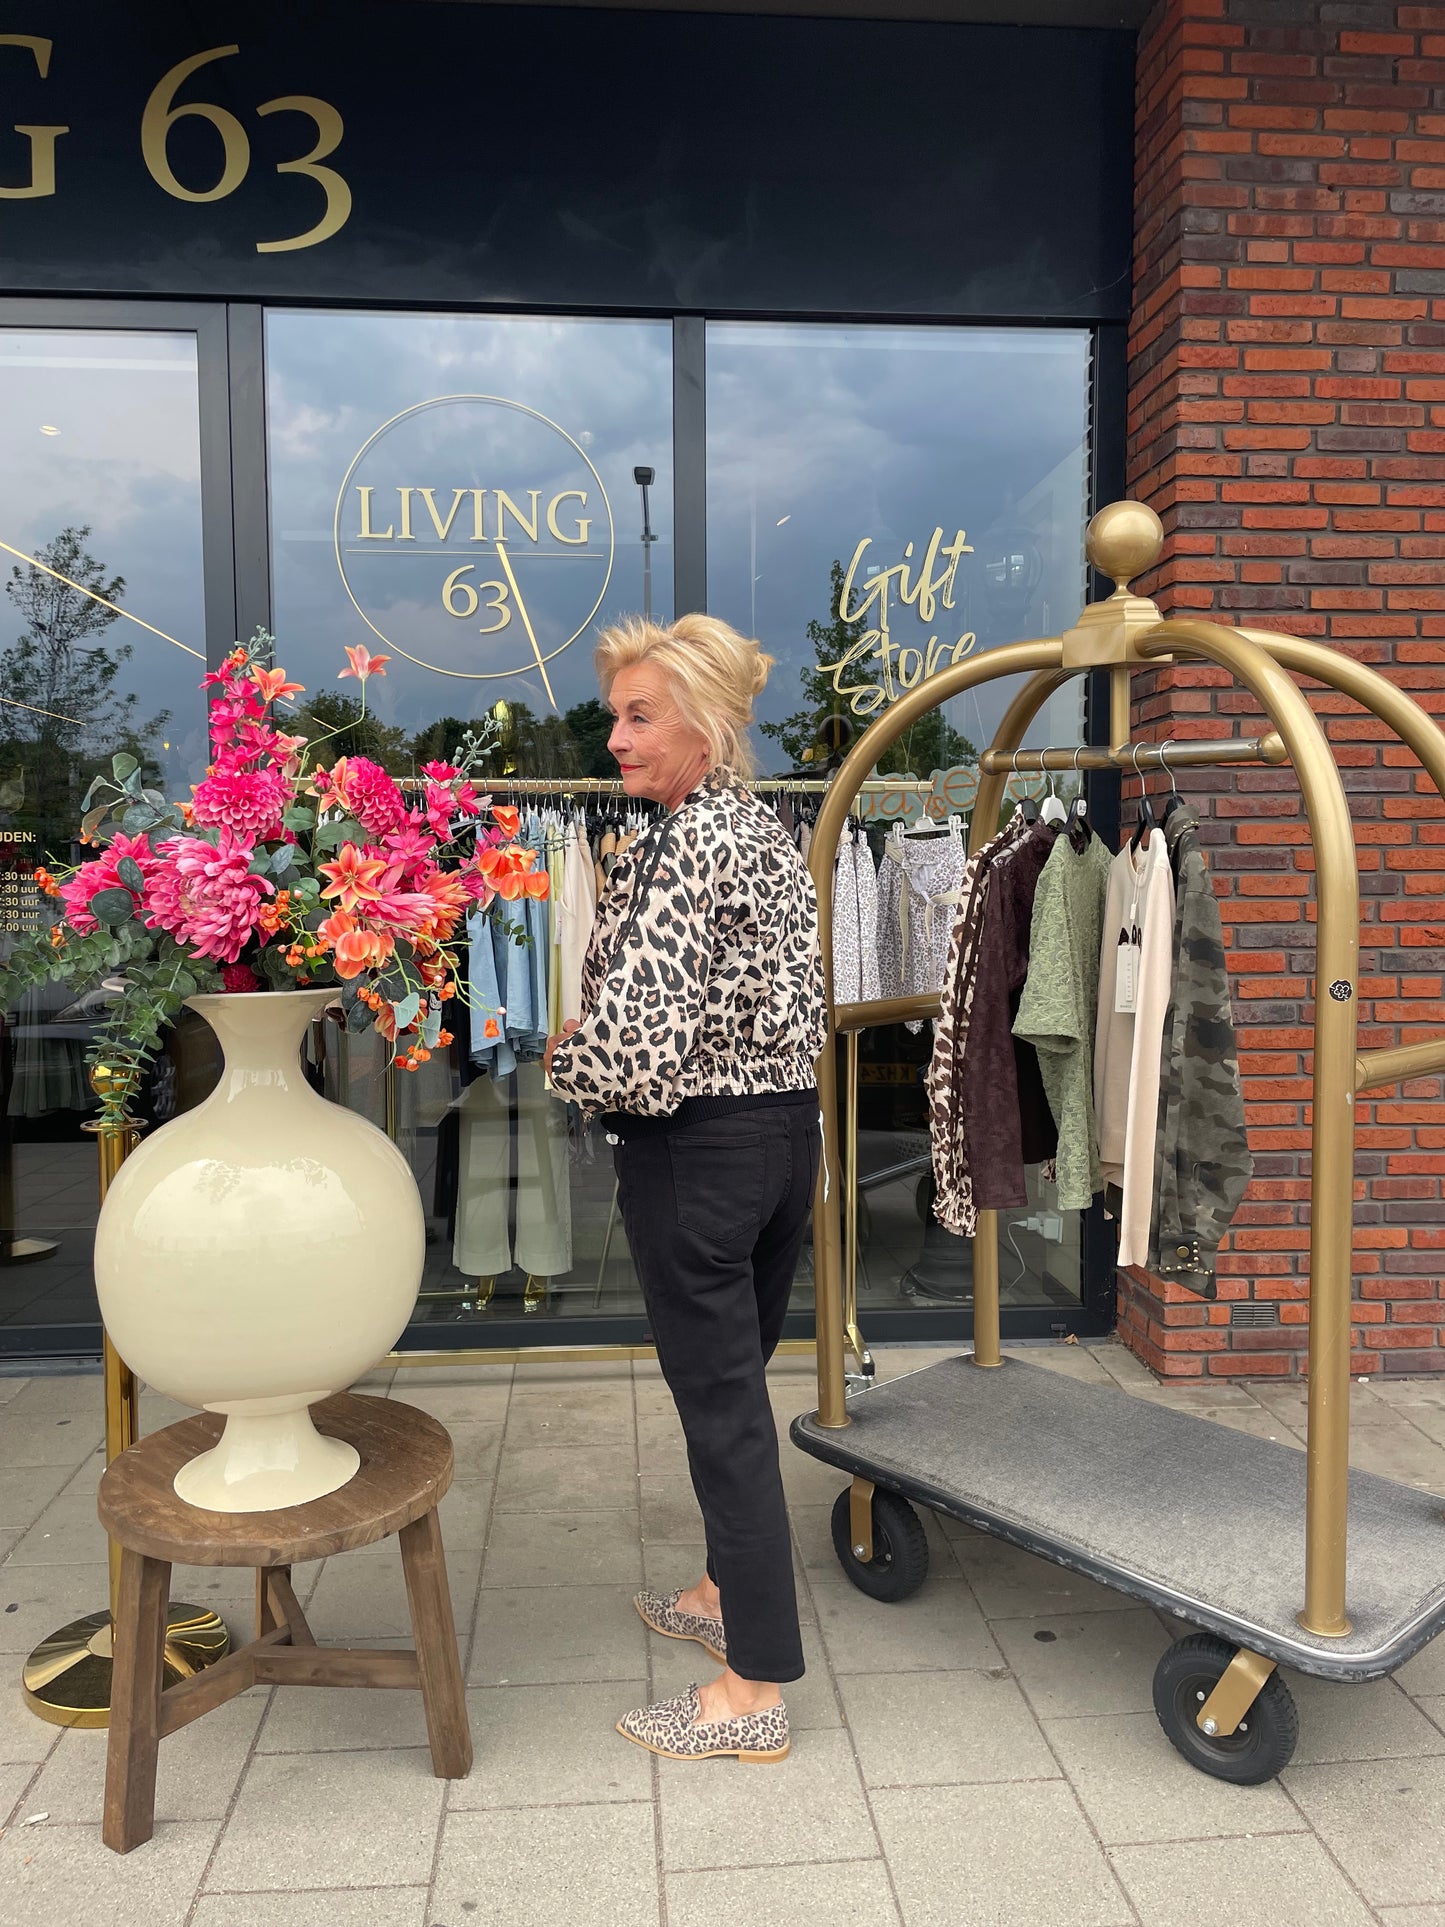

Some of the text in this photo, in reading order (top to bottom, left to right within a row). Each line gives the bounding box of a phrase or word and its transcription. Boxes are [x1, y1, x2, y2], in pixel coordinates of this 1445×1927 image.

[141, 44, 353, 253] 63
[355, 486, 593, 544] LIVING
[442, 564, 511, 634] 63
[839, 526, 975, 633] Gift
[21, 911, 40, 919] uur
